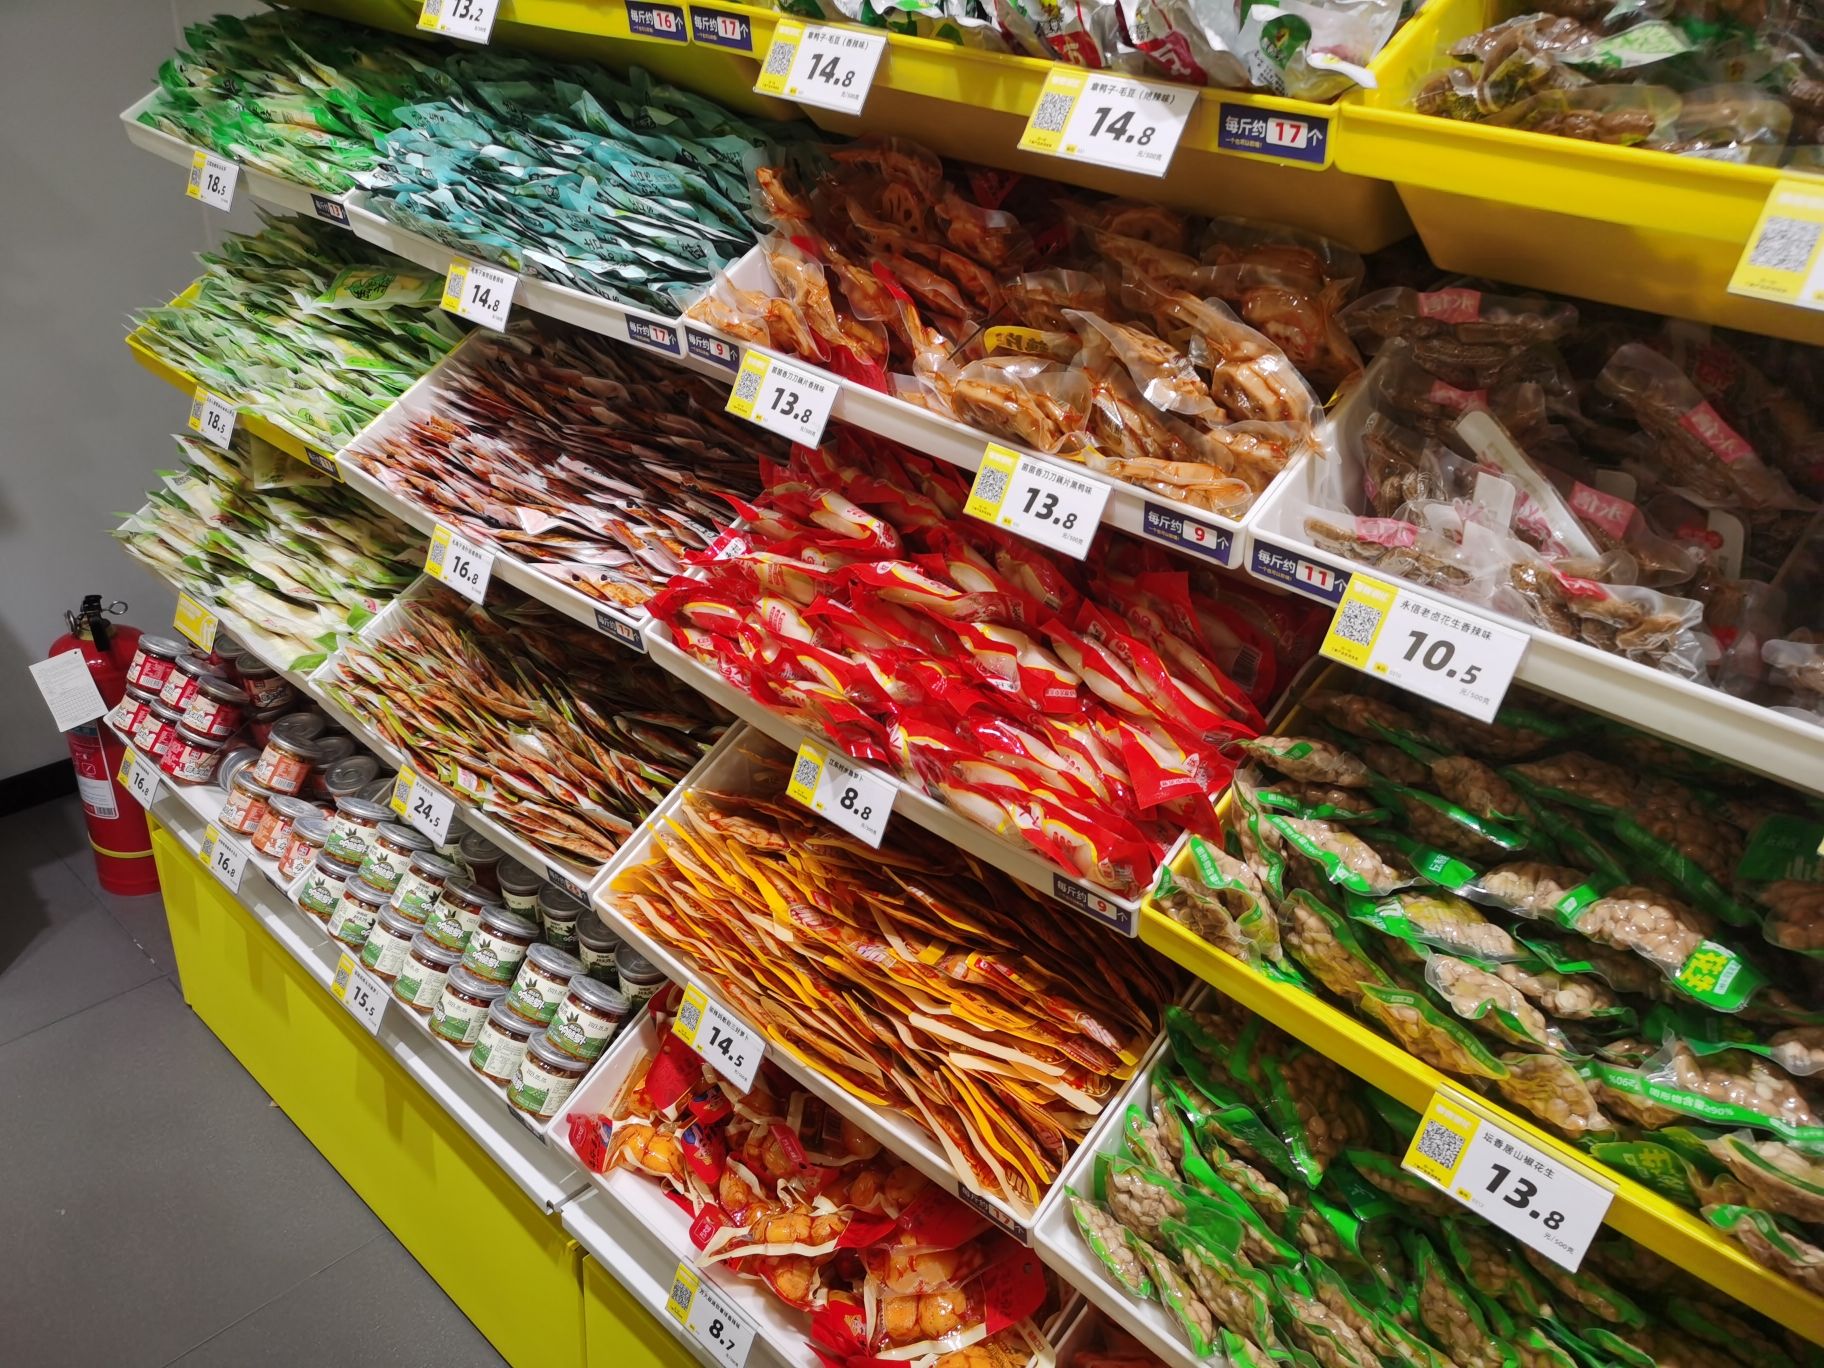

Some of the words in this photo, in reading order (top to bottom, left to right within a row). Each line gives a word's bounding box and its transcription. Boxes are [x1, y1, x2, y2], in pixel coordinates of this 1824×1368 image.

[452, 0, 484, 22] 13.2
[807, 53, 856, 88] 14.8
[1089, 107, 1156, 146] 14.8
[207, 174, 227, 196] 18.5
[472, 284, 500, 312] 14.8
[770, 387, 813, 424] 13.8
[207, 411, 226, 434] 18.5
[1022, 487, 1078, 530] 13.8
[452, 555, 479, 585] 16.8
[1400, 600, 1494, 641] 永信老卤花生香辣味
[1402, 630, 1483, 685] 10.5
[1458, 687, 1491, 706] 元/500克
[133, 772, 150, 796] 16.8
[413, 796, 441, 828] 24.5
[840, 787, 873, 821] 8.8
[217, 851, 236, 878] 16.8
[353, 985, 376, 1017] 15.5
[708, 1026, 745, 1067] 14.5
[1485, 1162, 1566, 1231] 13.8
[708, 1318, 736, 1351] 8.7
